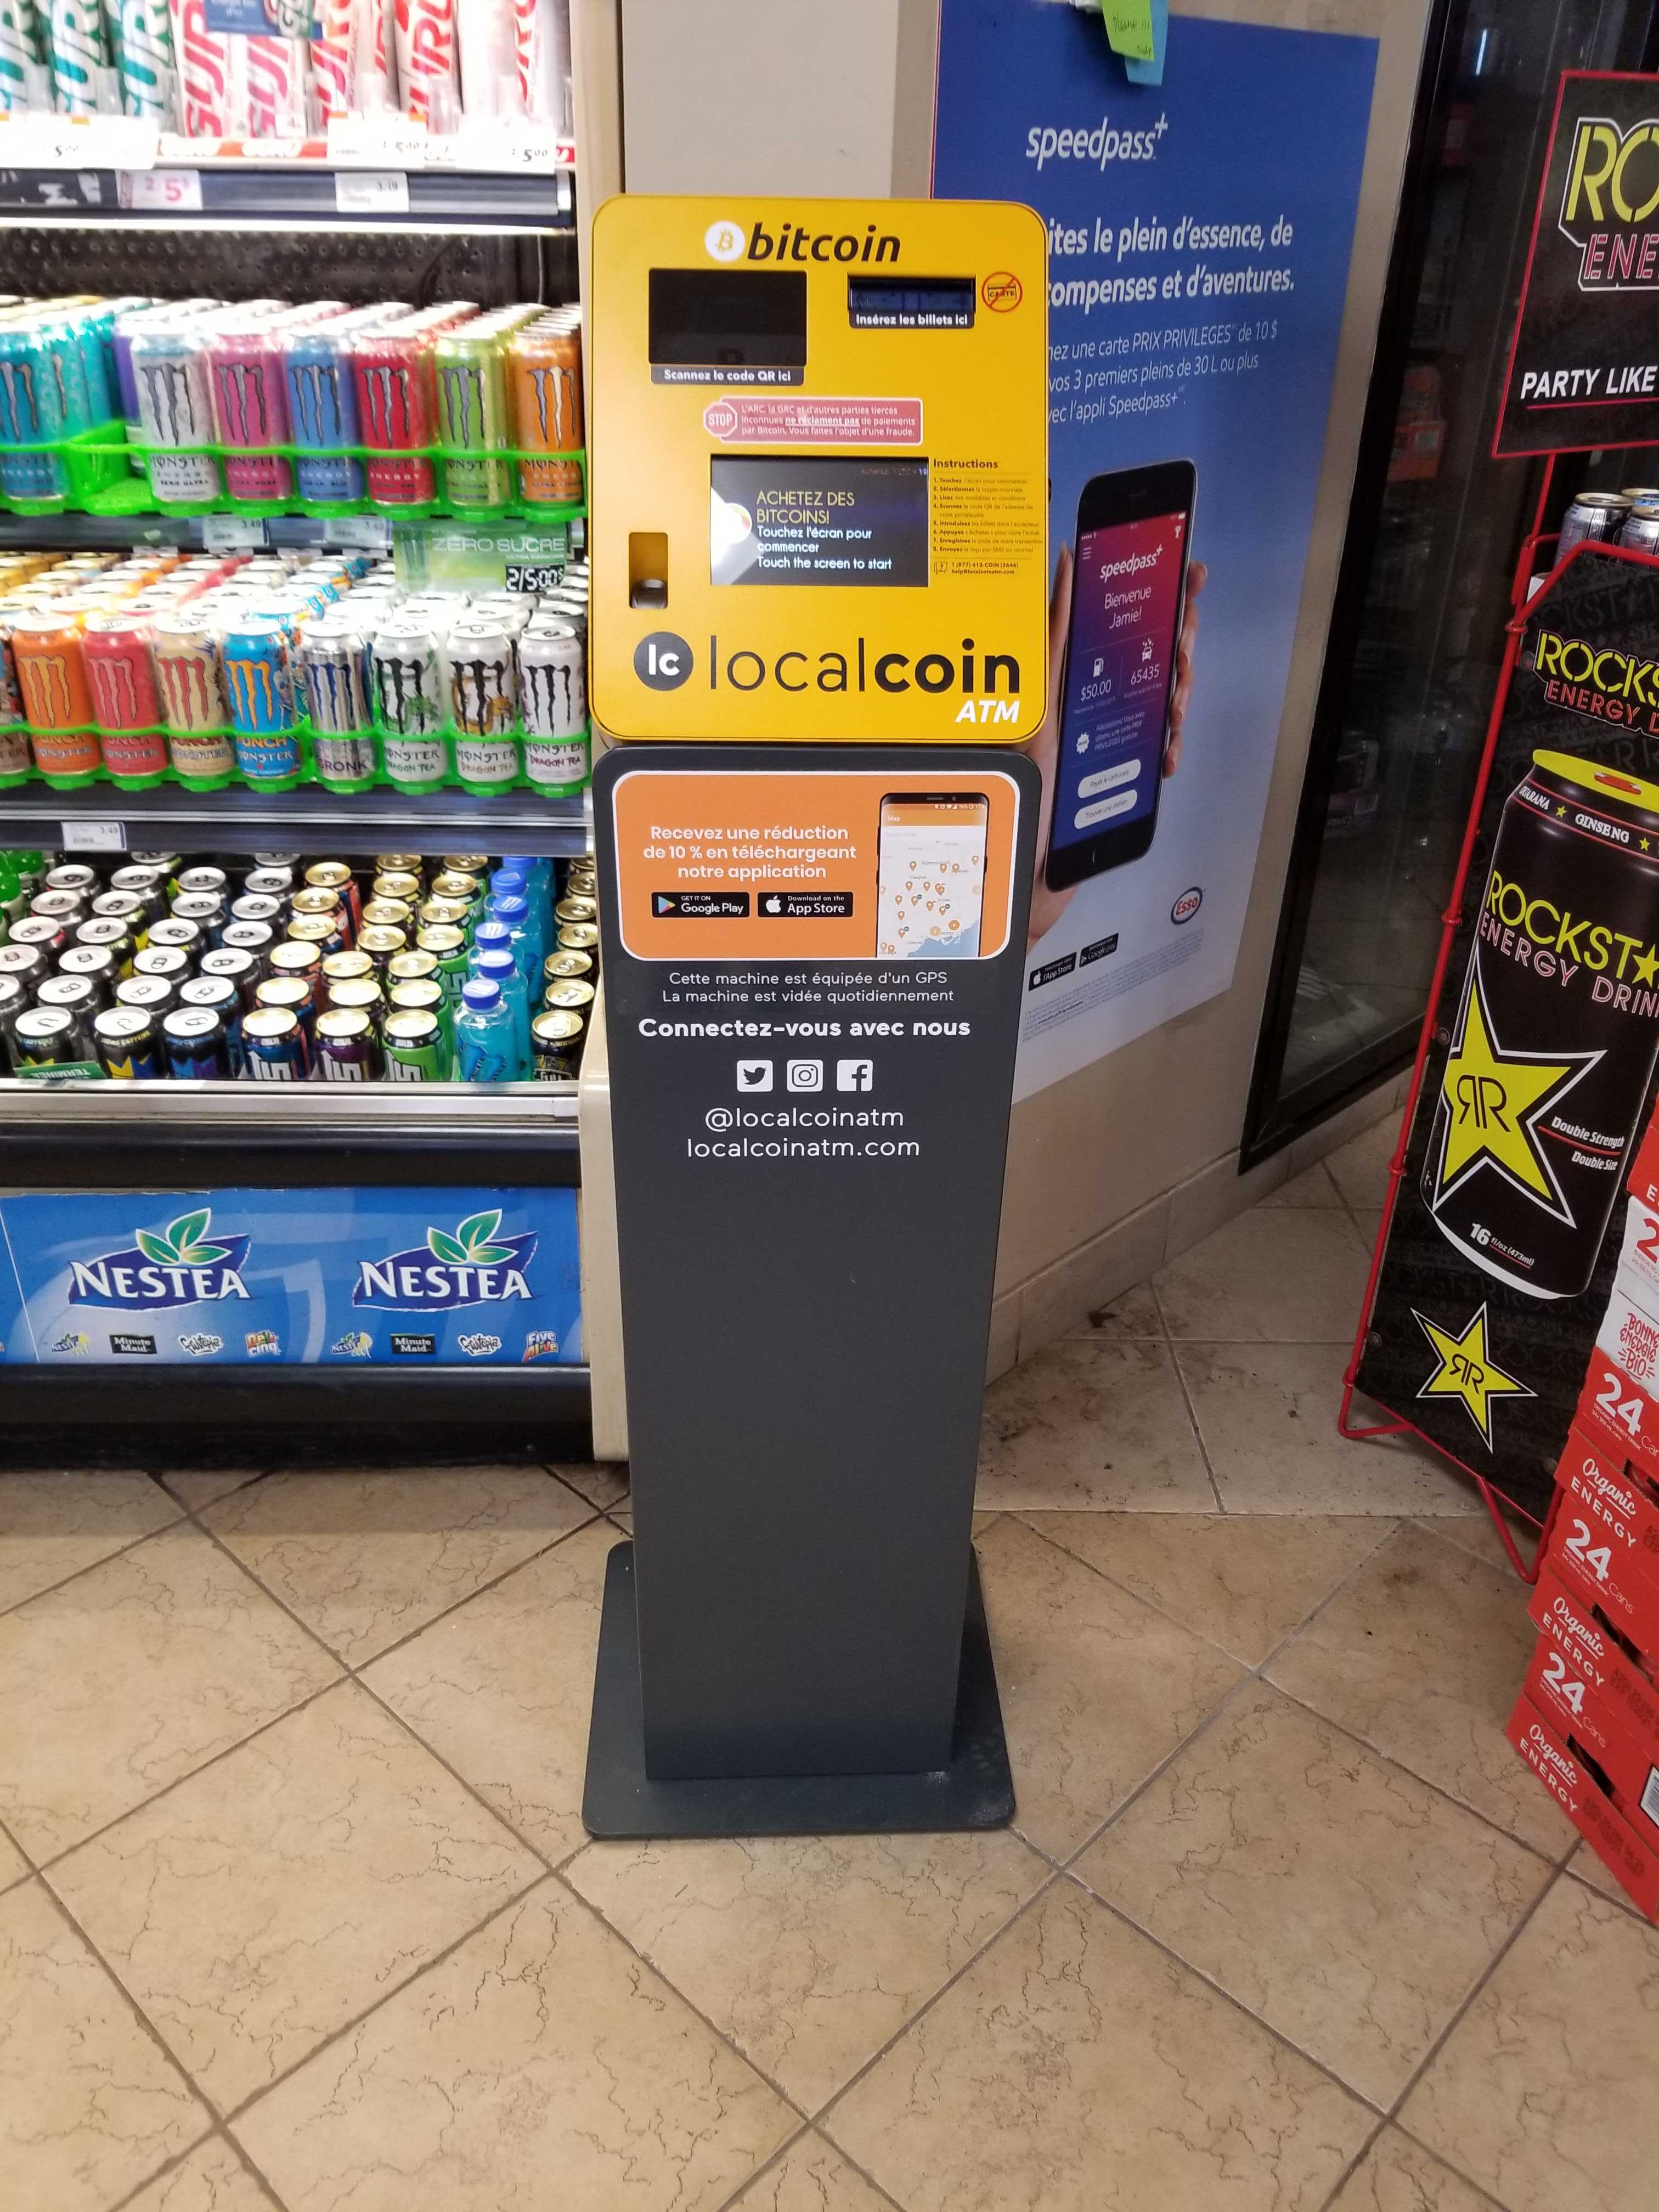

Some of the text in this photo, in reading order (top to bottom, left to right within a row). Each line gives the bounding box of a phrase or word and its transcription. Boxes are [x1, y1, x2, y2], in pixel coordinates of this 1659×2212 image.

[747, 222, 901, 262] bitcoin
[1094, 217, 1113, 253] le
[1117, 217, 1167, 263] plein
[1172, 216, 1265, 252] d'essence,
[1270, 214, 1293, 246] de
[1162, 270, 1182, 298] et
[1186, 264, 1295, 297] d'aventures.
[856, 314, 968, 325] Insérez les billets ici
[1071, 343, 1096, 358] une
[1098, 336, 1130, 357] carte
[1132, 331, 1161, 352] PRIX
[1238, 323, 1252, 342] de
[1256, 320, 1268, 341] 10
[1271, 319, 1278, 340] $
[663, 369, 791, 382] Scannez le code QR ici
[1048, 352, 1259, 394] vos 3 premiers pleins de 30 L ou plus
[1520, 365, 1657, 399] PARTY LIKE
[708, 414, 732, 426] STOP
[777, 405, 794, 414] GRC
[806, 406, 839, 414] d'autres
[842, 407, 868, 416] parties
[871, 407, 898, 415] tierces
[1069, 399, 1105, 425] l'appli
[789, 427, 809, 435] Vous
[811, 426, 833, 436] faites
[834, 426, 860, 437] l'objet
[861, 427, 884, 436] d'une
[886, 427, 915, 436] fraude.
[933, 459, 998, 469] Instructions
[757, 490, 855, 506] ACHETEZ DES
[757, 509, 830, 524] BITCOINS!
[431, 537, 565, 552] ZERO SUCRE
[757, 525, 872, 541] Touchez l'écran pour
[757, 543, 819, 553] commencer
[757, 556, 892, 570] Touch the screen to start
[1104, 586, 1152, 610] Bienvenue
[1109, 606, 1142, 629] Jamie!
[710, 635, 1020, 693] localcoin
[1130, 664, 1160, 685] 65435
[1080, 679, 1111, 702] $50.00
[1547, 679, 1640, 725] ENERGY
[955, 700, 1020, 724] ATM
[1518, 785, 1550, 810] GUARANA
[651, 824, 849, 841] Recevez une réduction
[1574, 813, 1630, 843] GINSENG
[643, 844, 856, 864] de 10 % en téléchargeant
[678, 865, 826, 883] notre application
[681, 902, 744, 916] Google Play
[787, 902, 845, 915] App Store
[1480, 912, 1579, 986] ENERGY
[669, 971, 947, 988] Cette machine est équipée d'un GPS
[663, 989, 954, 1005] La machine est vidée quotidiennement
[638, 1018, 971, 1037] Connectez-vous avec nous
[705, 1107, 904, 1132] @localcoinatm
[1551, 1115, 1625, 1149] Double Strength
[687, 1137, 920, 1158] localcoinatm.com
[1571, 1150, 1618, 1171] Double Size
[1470, 1222, 1491, 1246] 16
[1507, 1246, 1535, 1267] (473ml)
[68, 1260, 253, 1300] NESTEA
[358, 1261, 535, 1301] NESTEA
[395, 1337, 432, 1346] Minute
[400, 1345, 427, 1353] Maid
[1595, 1373, 1644, 1437] 24
[1582, 1458, 1637, 1516] Organic
[1571, 1475, 1637, 1548] ENERGY
[1565, 1518, 1612, 1582] 24
[1553, 1596, 1605, 1657] Organic
[1543, 1612, 1605, 1687] ENERGY
[1542, 1651, 1585, 1716] 24
[1530, 1724, 1578, 1786] Organic
[1520, 1736, 1578, 1813] ENERGY
